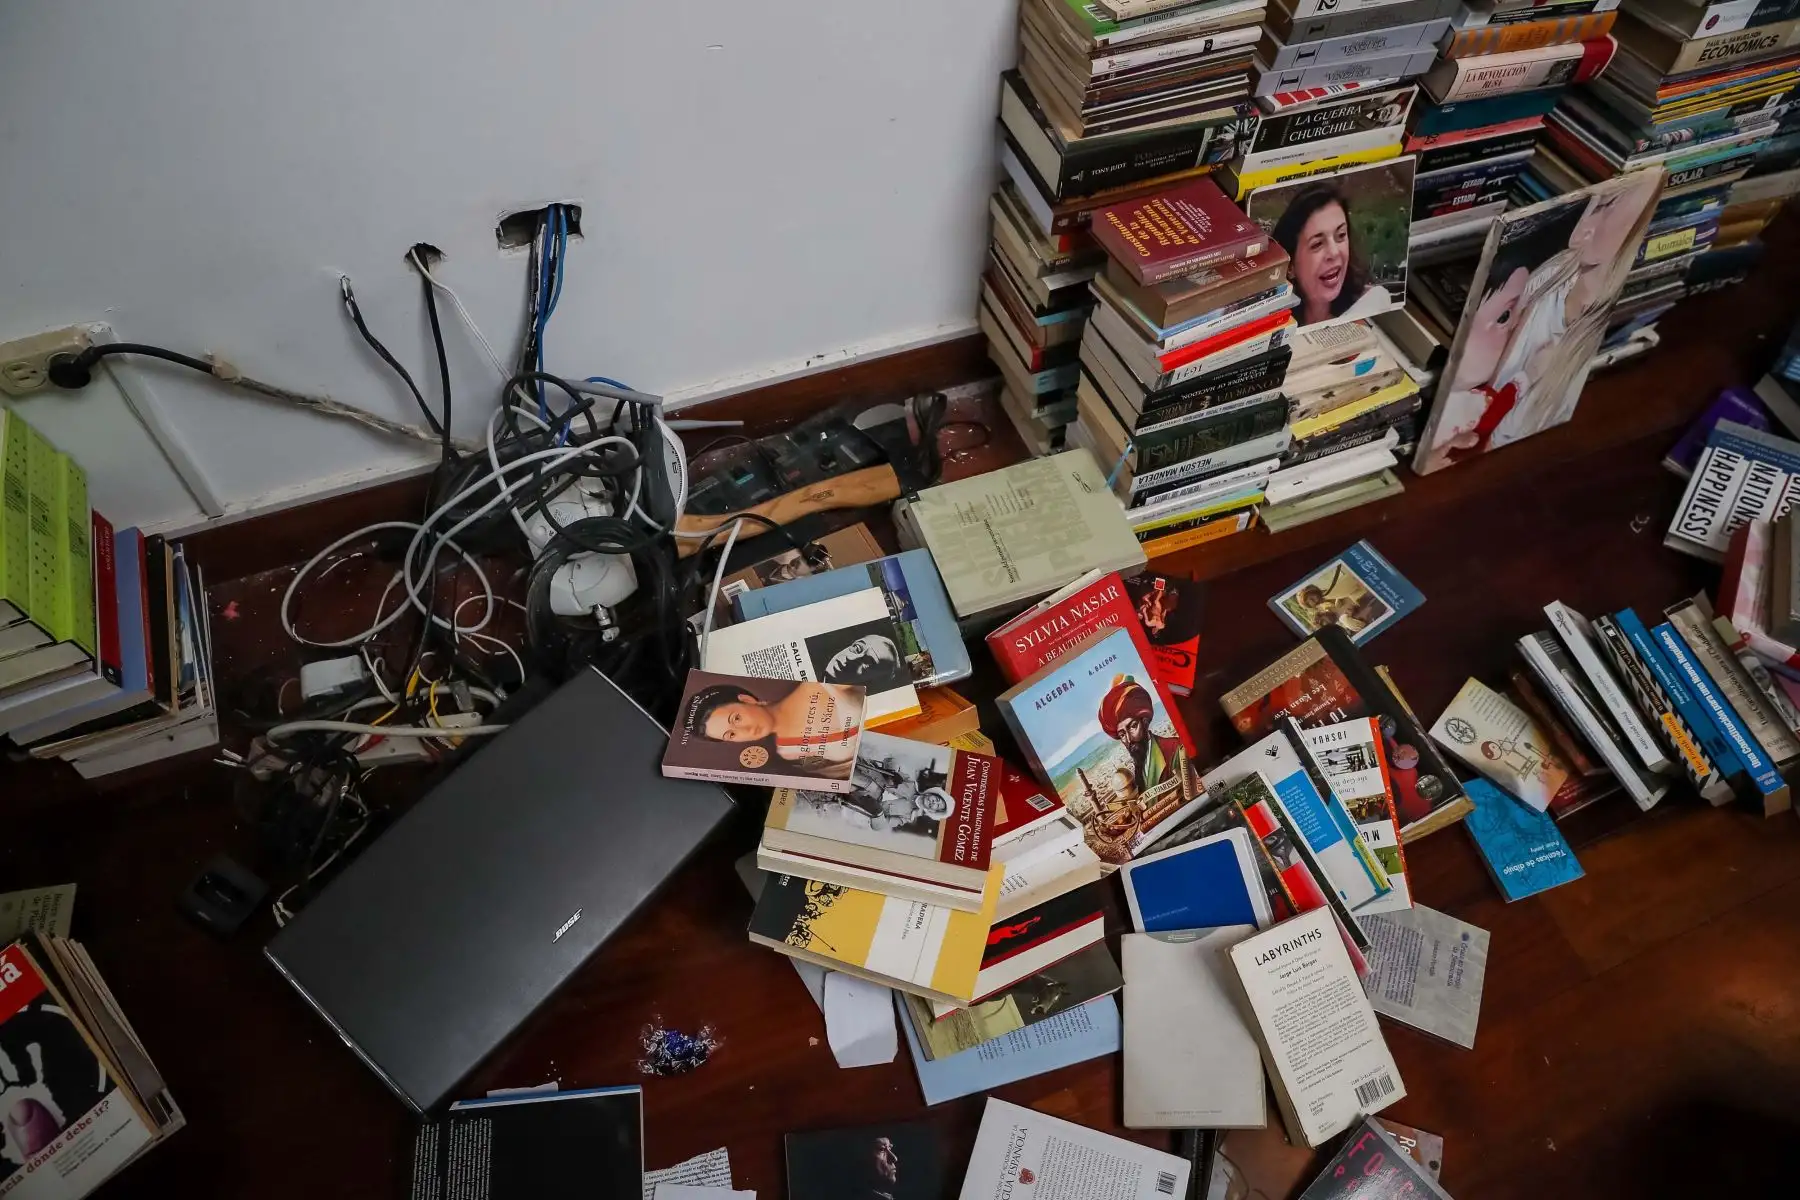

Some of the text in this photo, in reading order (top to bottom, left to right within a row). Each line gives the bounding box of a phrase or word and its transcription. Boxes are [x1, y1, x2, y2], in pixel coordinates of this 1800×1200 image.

[1698, 35, 1779, 62] ECONOMICS
[1466, 73, 1477, 82] LA
[1295, 105, 1362, 126] LA GUERRA
[1289, 121, 1356, 142] CHURCHILL
[1091, 162, 1127, 176] TONY JUDT
[1670, 168, 1703, 185] SOLAR
[1452, 193, 1476, 205] ESTADO
[1129, 222, 1150, 240] de la
[1134, 210, 1171, 247] República
[1143, 204, 1185, 246] Bolivariana
[1152, 199, 1189, 235] Venezuela
[1105, 212, 1150, 257] Constitución
[1187, 234, 1200, 245] de
[1138, 458, 1212, 485] NELSON MANDELA
[1683, 450, 1741, 537] HAPPINESS
[1727, 463, 1778, 533] NATIONAL
[1016, 585, 1120, 654] SYLVIA NASAR
[1037, 612, 1120, 668] A BEAUTIFUL MIND
[790, 641, 804, 668] SAUL
[1095, 654, 1117, 673] BALDOR
[1035, 679, 1076, 711] ALGEBRA
[1274, 684, 1327, 720] Lee Kuan Yew
[1660, 631, 1761, 768] Una Constitución para una Nueva República
[806, 704, 818, 725] eres
[799, 724, 814, 754] gloria
[812, 696, 836, 765] Manuela Sáenz
[1313, 731, 1347, 745] JOSHUA
[955, 755, 981, 862] JUAN VICENTE GÓMEZ
[970, 761, 991, 862] CONFIDENCIAS IMAGINARIAS DE
[1503, 863, 1525, 875] dibujo
[1536, 849, 1566, 862] Técnicas
[555, 911, 581, 938] BOSE
[1255, 928, 1322, 966] LABYRINTHS
[1293, 965, 1302, 974] Luis
[26, 1140, 64, 1174] dónde
[65, 1116, 93, 1142] debe
[94, 1100, 110, 1122] ir?
[1002, 1127, 1028, 1200] GUA ESPAÑOLA
